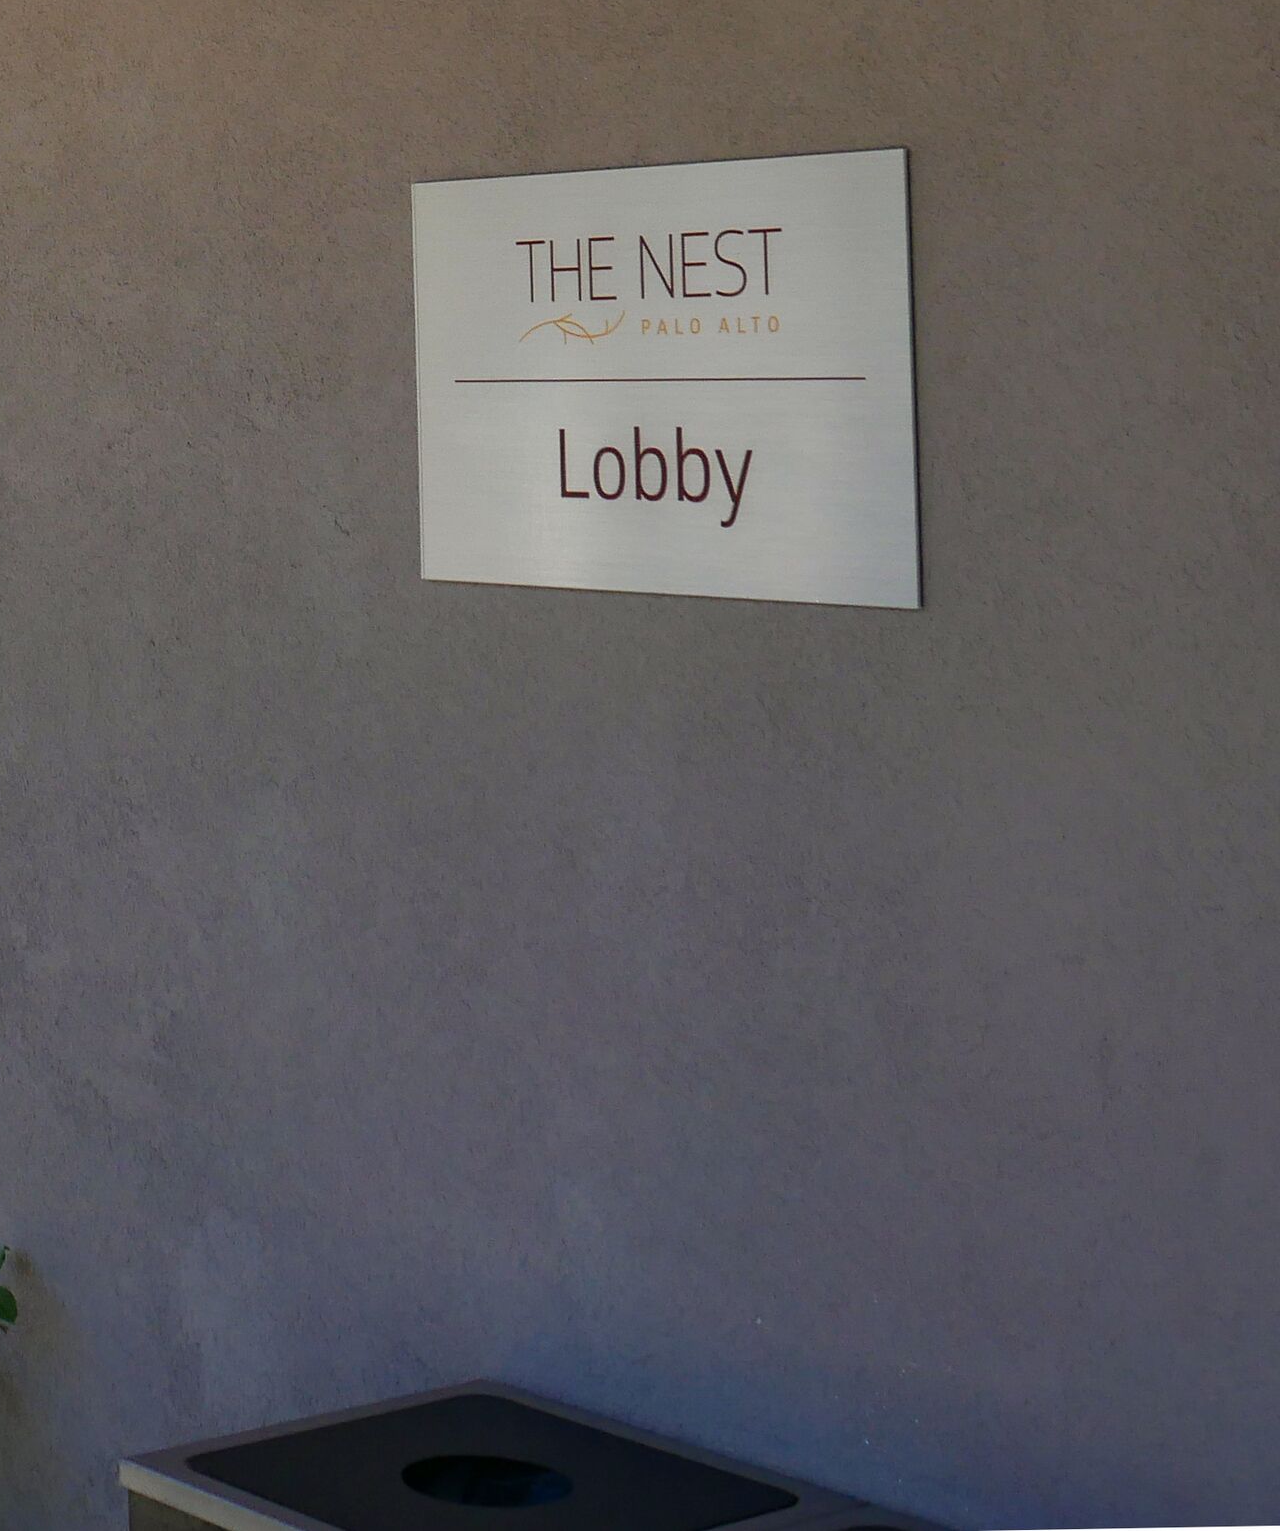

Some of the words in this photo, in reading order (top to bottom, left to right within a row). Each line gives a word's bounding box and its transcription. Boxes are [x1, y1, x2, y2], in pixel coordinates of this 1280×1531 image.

[515, 236, 617, 303] THE
[639, 228, 783, 300] NEST
[640, 317, 702, 335] PALO
[718, 315, 781, 334] ALTO
[557, 426, 754, 529] Lobby
